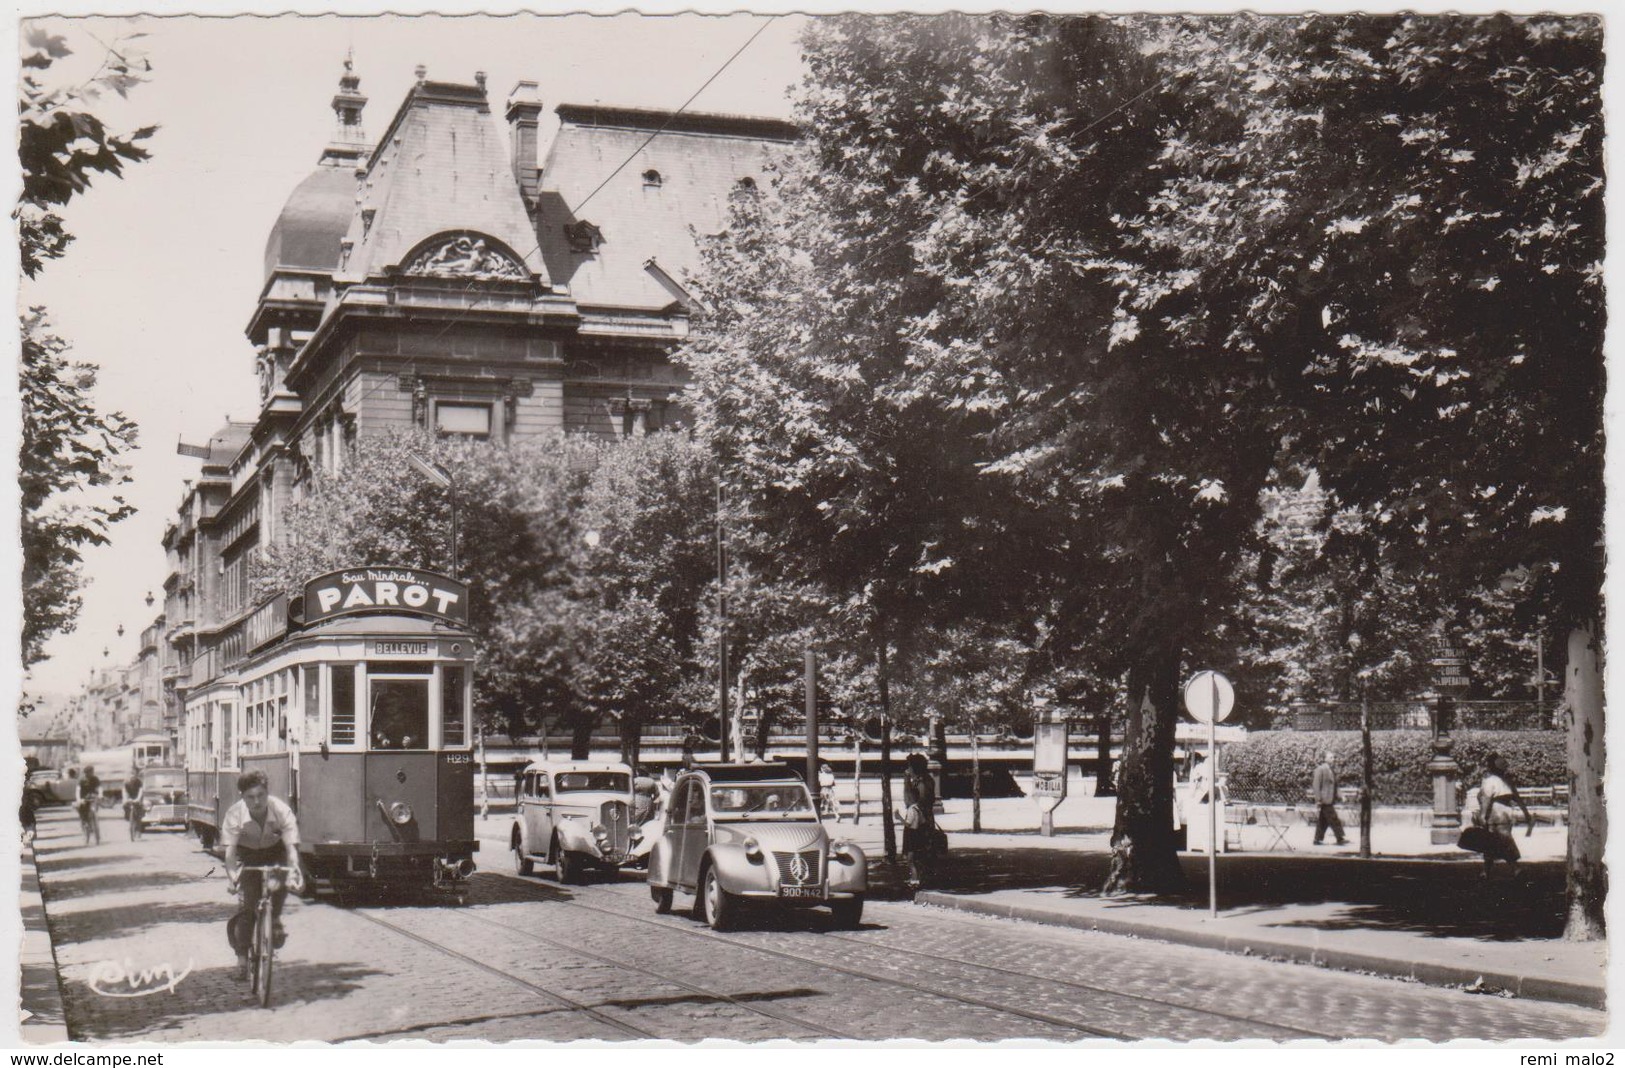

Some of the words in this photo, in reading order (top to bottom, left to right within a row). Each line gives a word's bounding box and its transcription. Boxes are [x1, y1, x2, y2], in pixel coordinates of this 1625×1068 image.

[342, 572, 366, 584] Eau
[317, 582, 459, 614] PAROT
[376, 643, 427, 655] BELLEVUE
